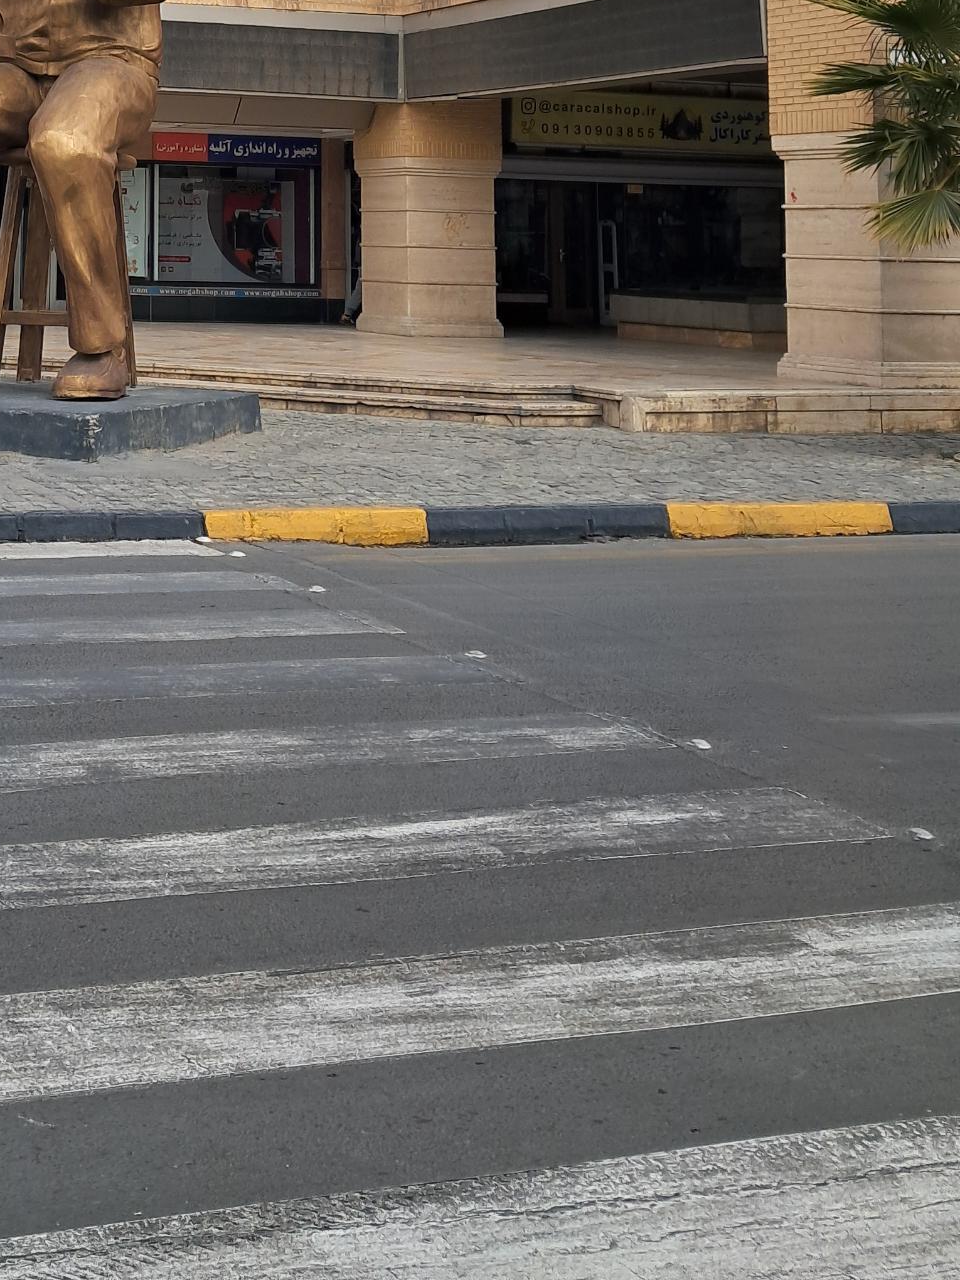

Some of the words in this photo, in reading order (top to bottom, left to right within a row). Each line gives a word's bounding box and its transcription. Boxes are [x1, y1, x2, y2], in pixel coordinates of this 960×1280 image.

[539, 100, 656, 118] @caracalshop.ir
[208, 139, 232, 155] آتلیه
[283, 148, 289, 158] و
[291, 144, 317, 158] تجهیز
[159, 287, 236, 297] www.negahshop.com
